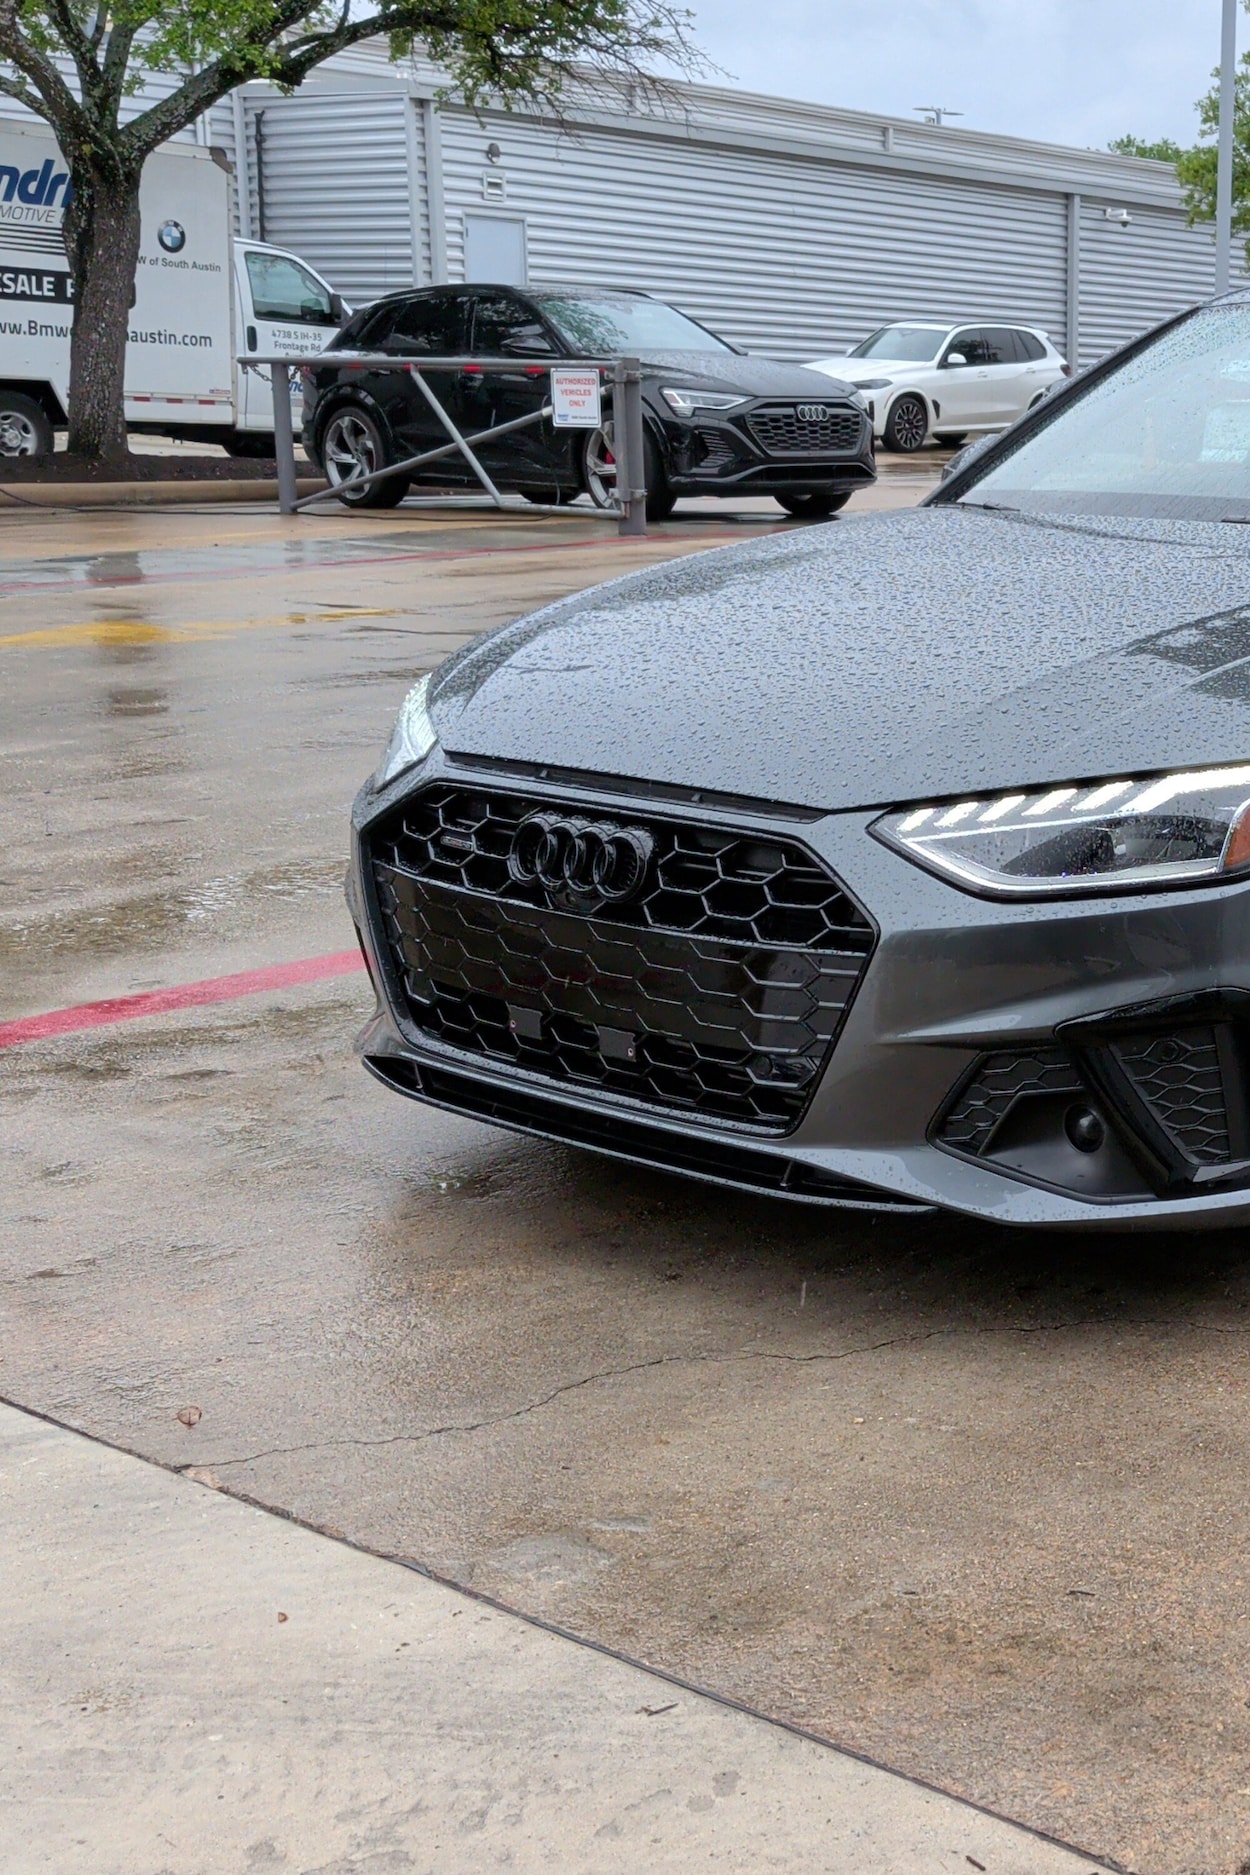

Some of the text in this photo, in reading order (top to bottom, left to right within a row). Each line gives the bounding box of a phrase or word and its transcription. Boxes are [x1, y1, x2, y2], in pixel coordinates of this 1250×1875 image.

[149, 257, 159, 266] of
[161, 258, 189, 269] South
[191, 261, 221, 272] Austin
[273, 341, 321, 353] Frontage Rd
[555, 378, 596, 386] AUTHORIZED
